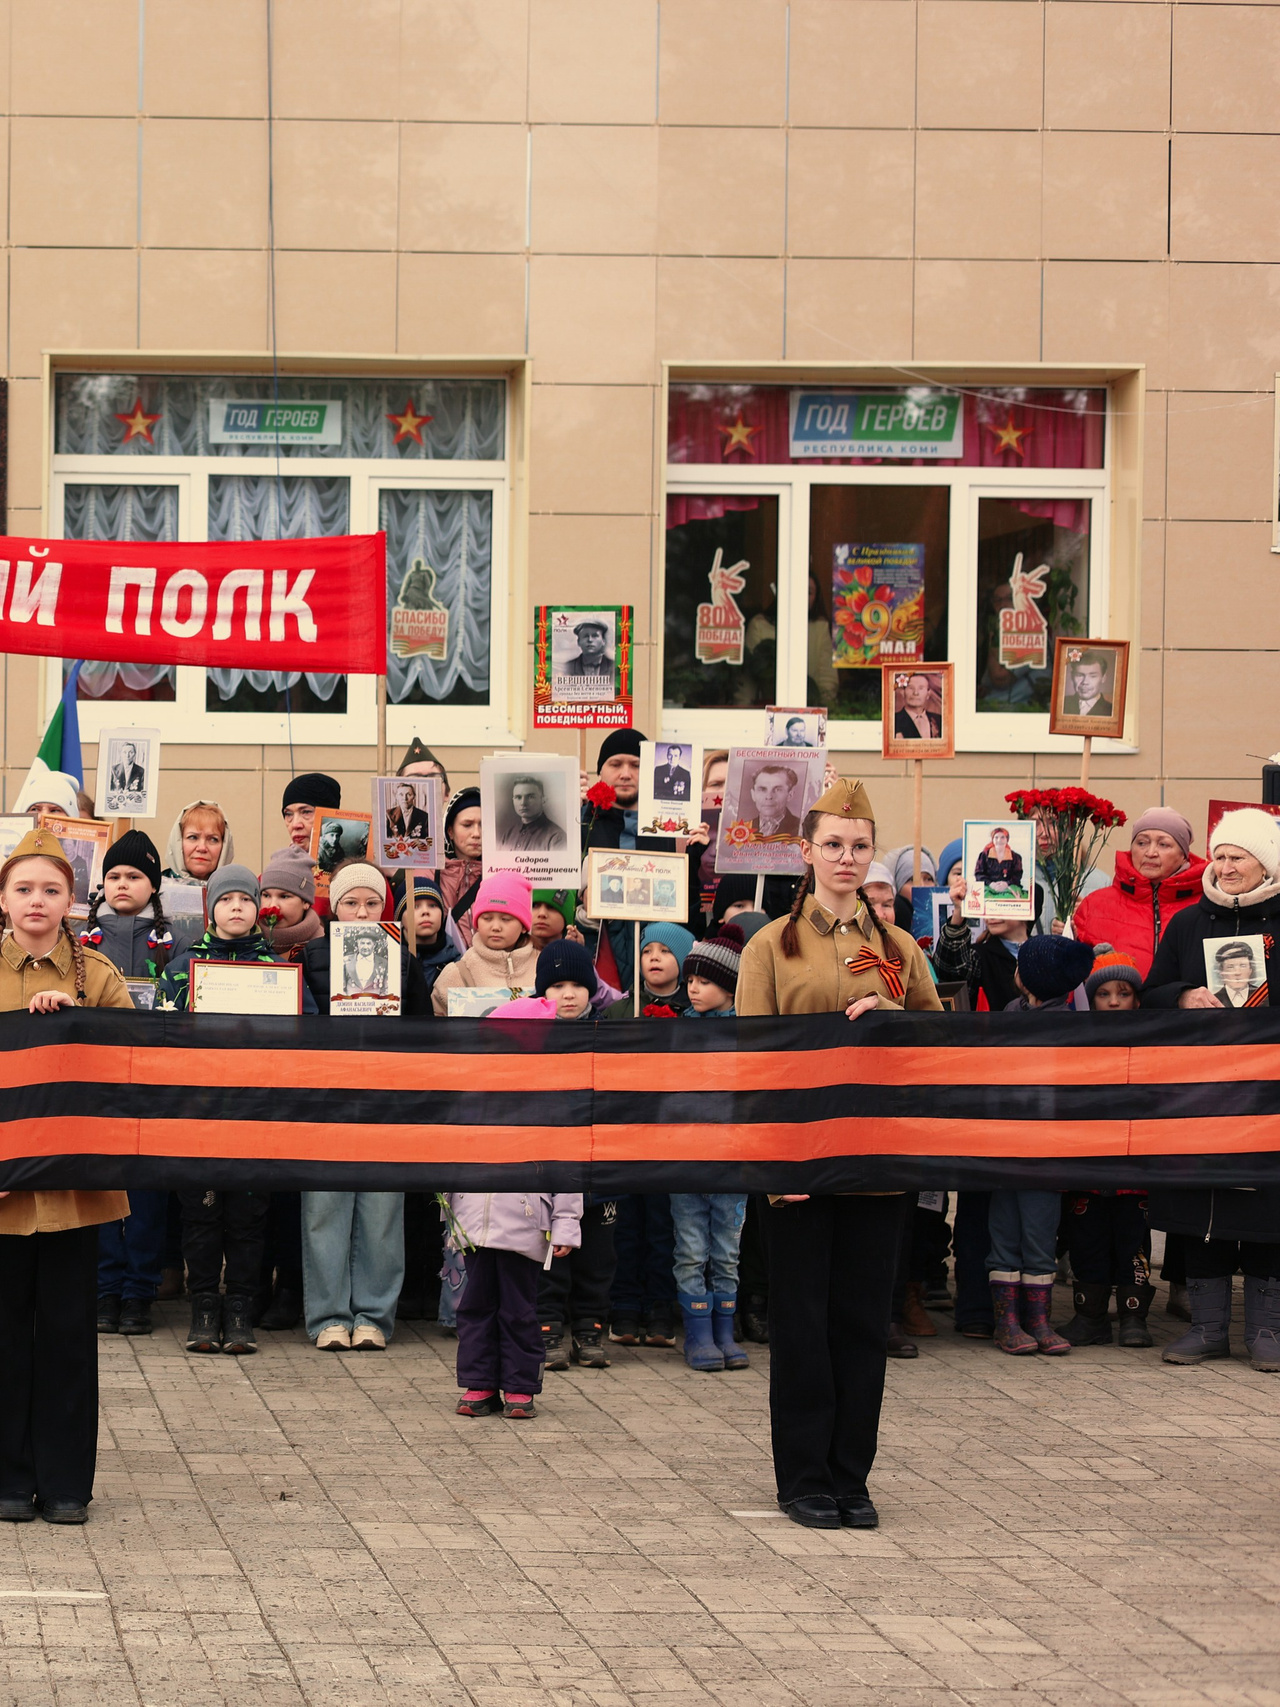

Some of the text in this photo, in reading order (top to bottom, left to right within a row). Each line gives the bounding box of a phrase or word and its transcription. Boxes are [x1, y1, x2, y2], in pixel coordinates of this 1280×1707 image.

[229, 409, 320, 429] ГОД ГЕРОЕВ
[803, 404, 948, 435] ГОД ГЕРОЕВ
[803, 445, 939, 454] РЕСПУБЛИКА КОМИ
[105, 566, 319, 644] ПОЛК
[394, 610, 446, 625] СПАСИБО
[699, 605, 723, 627] 80
[861, 600, 892, 646] 9
[1002, 610, 1025, 632] 80
[393, 625, 446, 637] ЗА ПОБЕДУ!
[698, 630, 742, 644] ПОБЕДА!
[880, 640, 917, 654] МАЯ
[1002, 634, 1045, 649] ПОБЕДА!
[557, 676, 610, 685] ВЕРШИНИН
[537, 704, 627, 715] БЕССМЕРТНЫЙ,
[536, 715, 629, 725] ПОБЕДНЫЙ ПОЛК!
[736, 750, 820, 759] БЕССМЕРТНЫЙ ПОЛК
[514, 856, 549, 865] Сидоров
[522, 865, 579, 875] Дмитриевич
